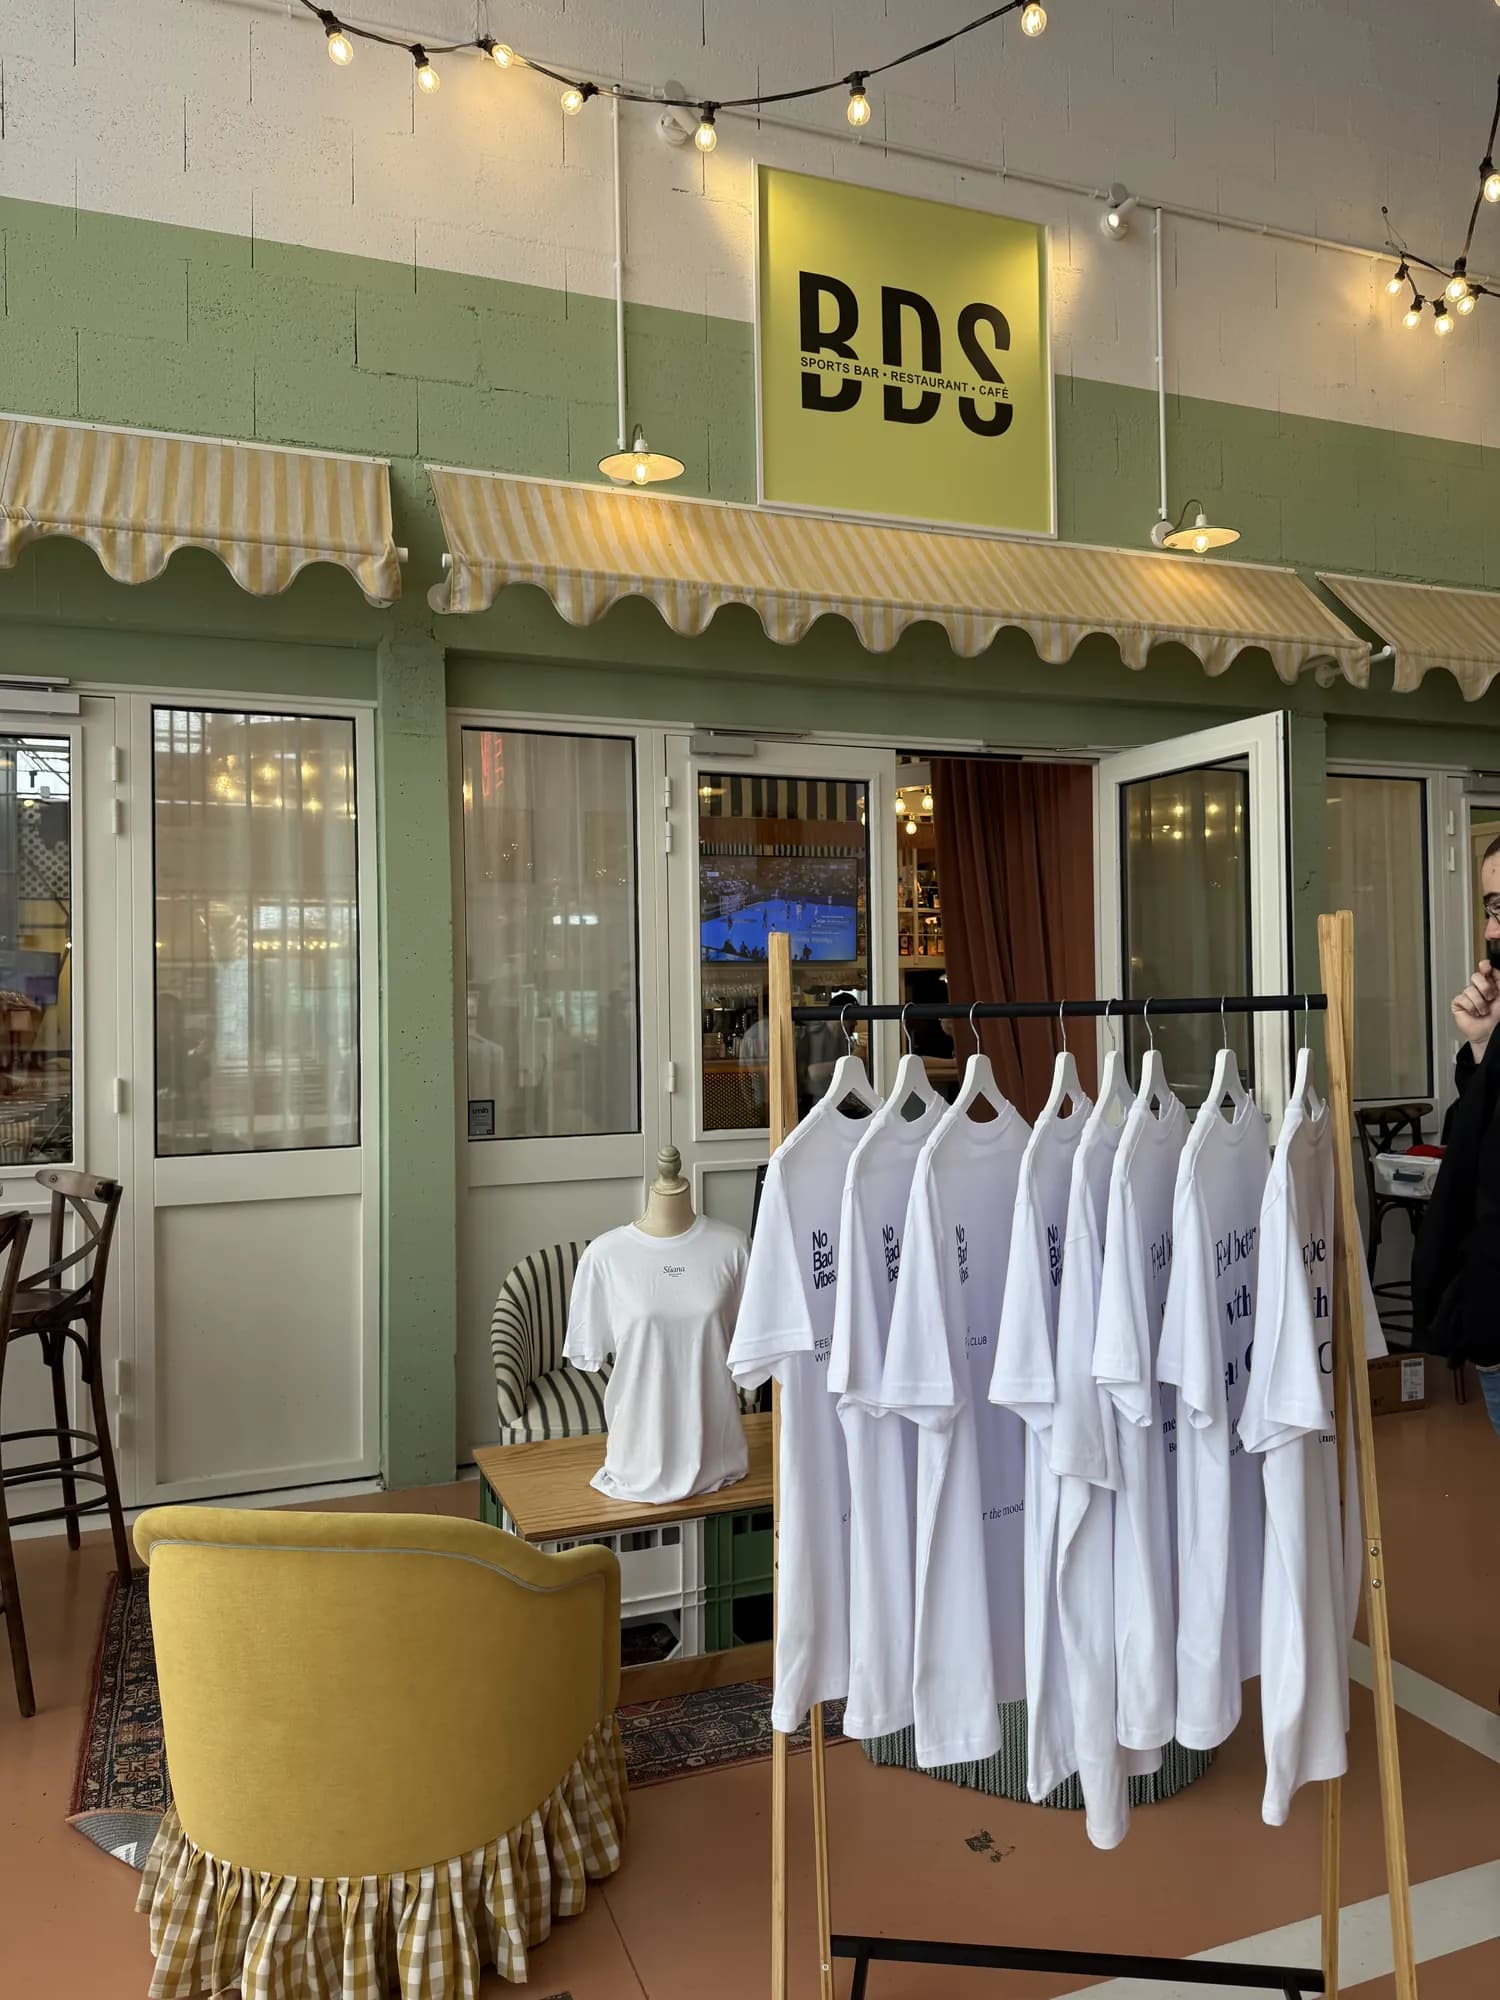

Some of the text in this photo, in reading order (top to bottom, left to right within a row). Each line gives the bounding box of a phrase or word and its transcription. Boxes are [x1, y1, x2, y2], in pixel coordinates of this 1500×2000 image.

[799, 271, 1013, 437] BDS
[800, 356, 1009, 399] SPORTS BAR RESTAURANT CAFÉ
[812, 1229, 828, 1251] No
[882, 1224, 894, 1247] No
[813, 1245, 833, 1272] Bad
[813, 1269, 837, 1290] Vibes
[970, 1335, 987, 1346] CLUB
[814, 1350, 831, 1363] WIT
[989, 1507, 1002, 1520] the
[1002, 1499, 1025, 1516] mood
